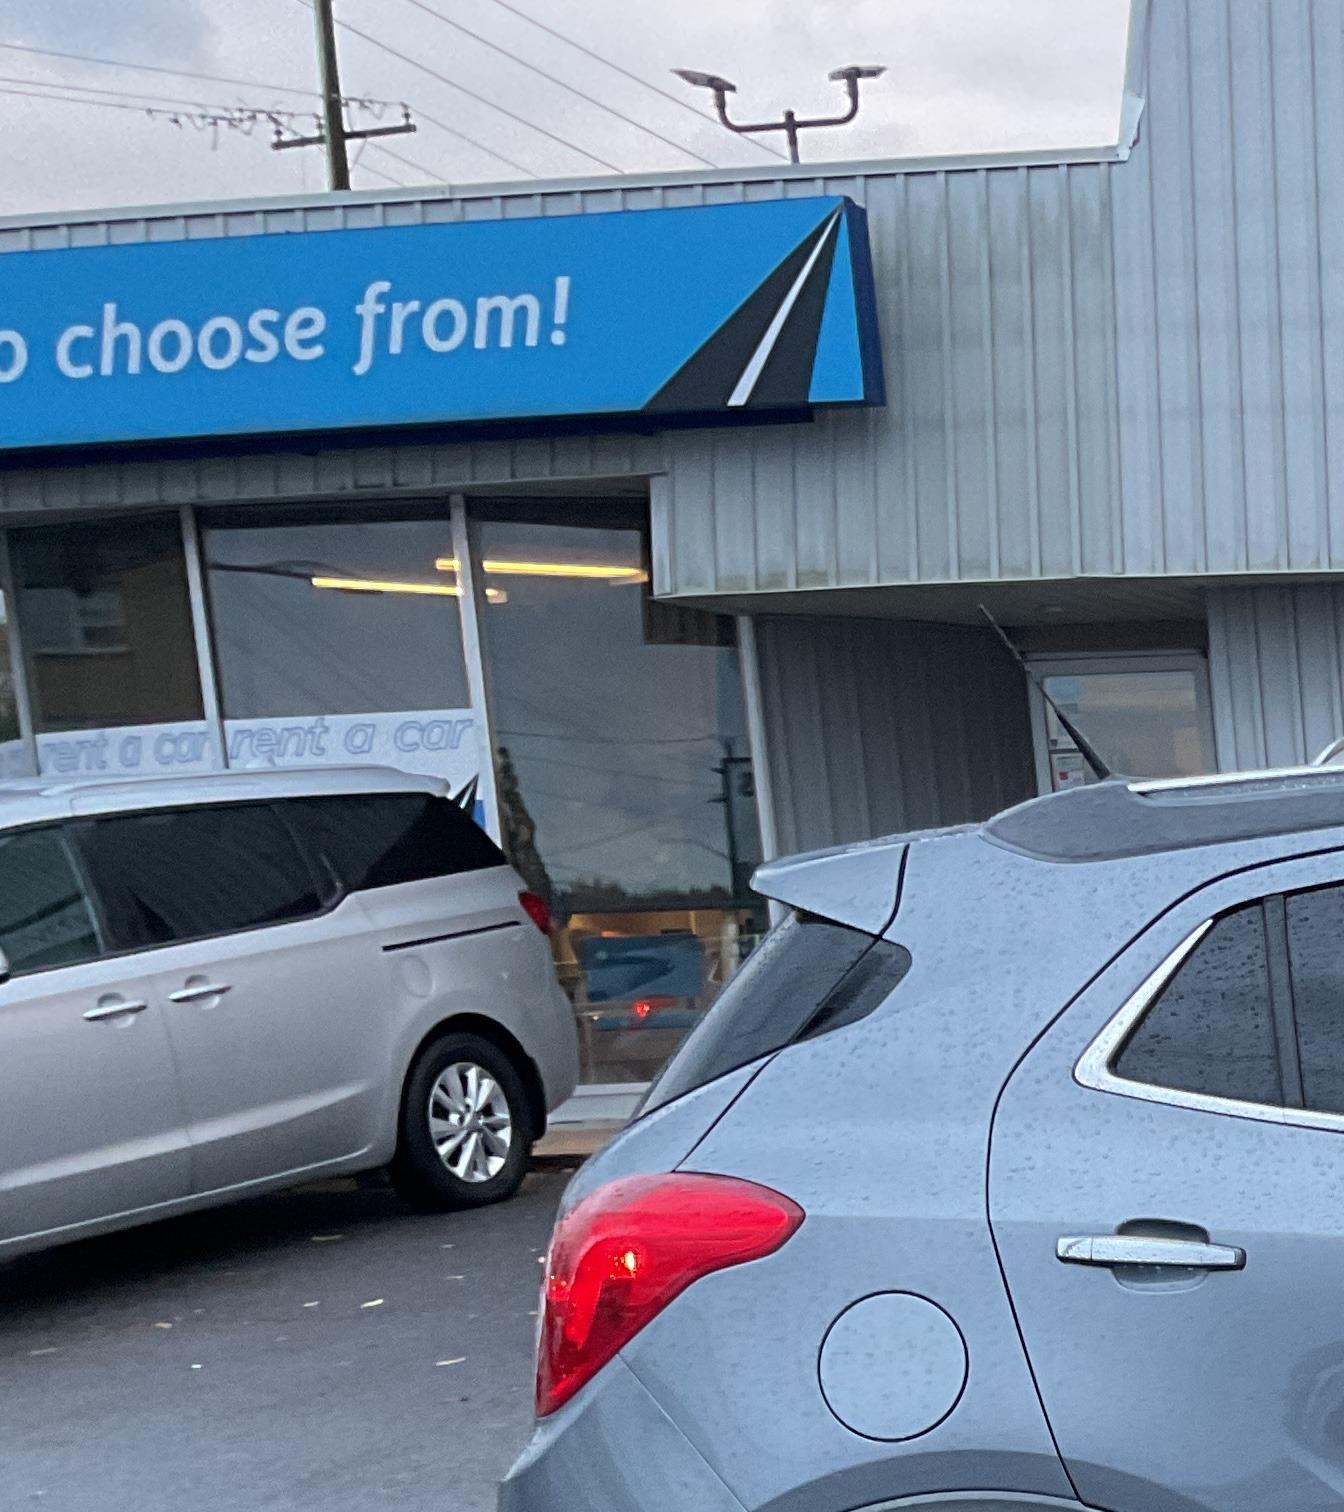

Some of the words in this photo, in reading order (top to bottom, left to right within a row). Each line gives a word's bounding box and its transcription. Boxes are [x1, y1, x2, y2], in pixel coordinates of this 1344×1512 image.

[55, 302, 326, 379] choose
[352, 275, 571, 377] from!
[118, 735, 142, 767] a
[229, 717, 329, 760] rent
[344, 723, 376, 754] a
[393, 718, 474, 752] car
